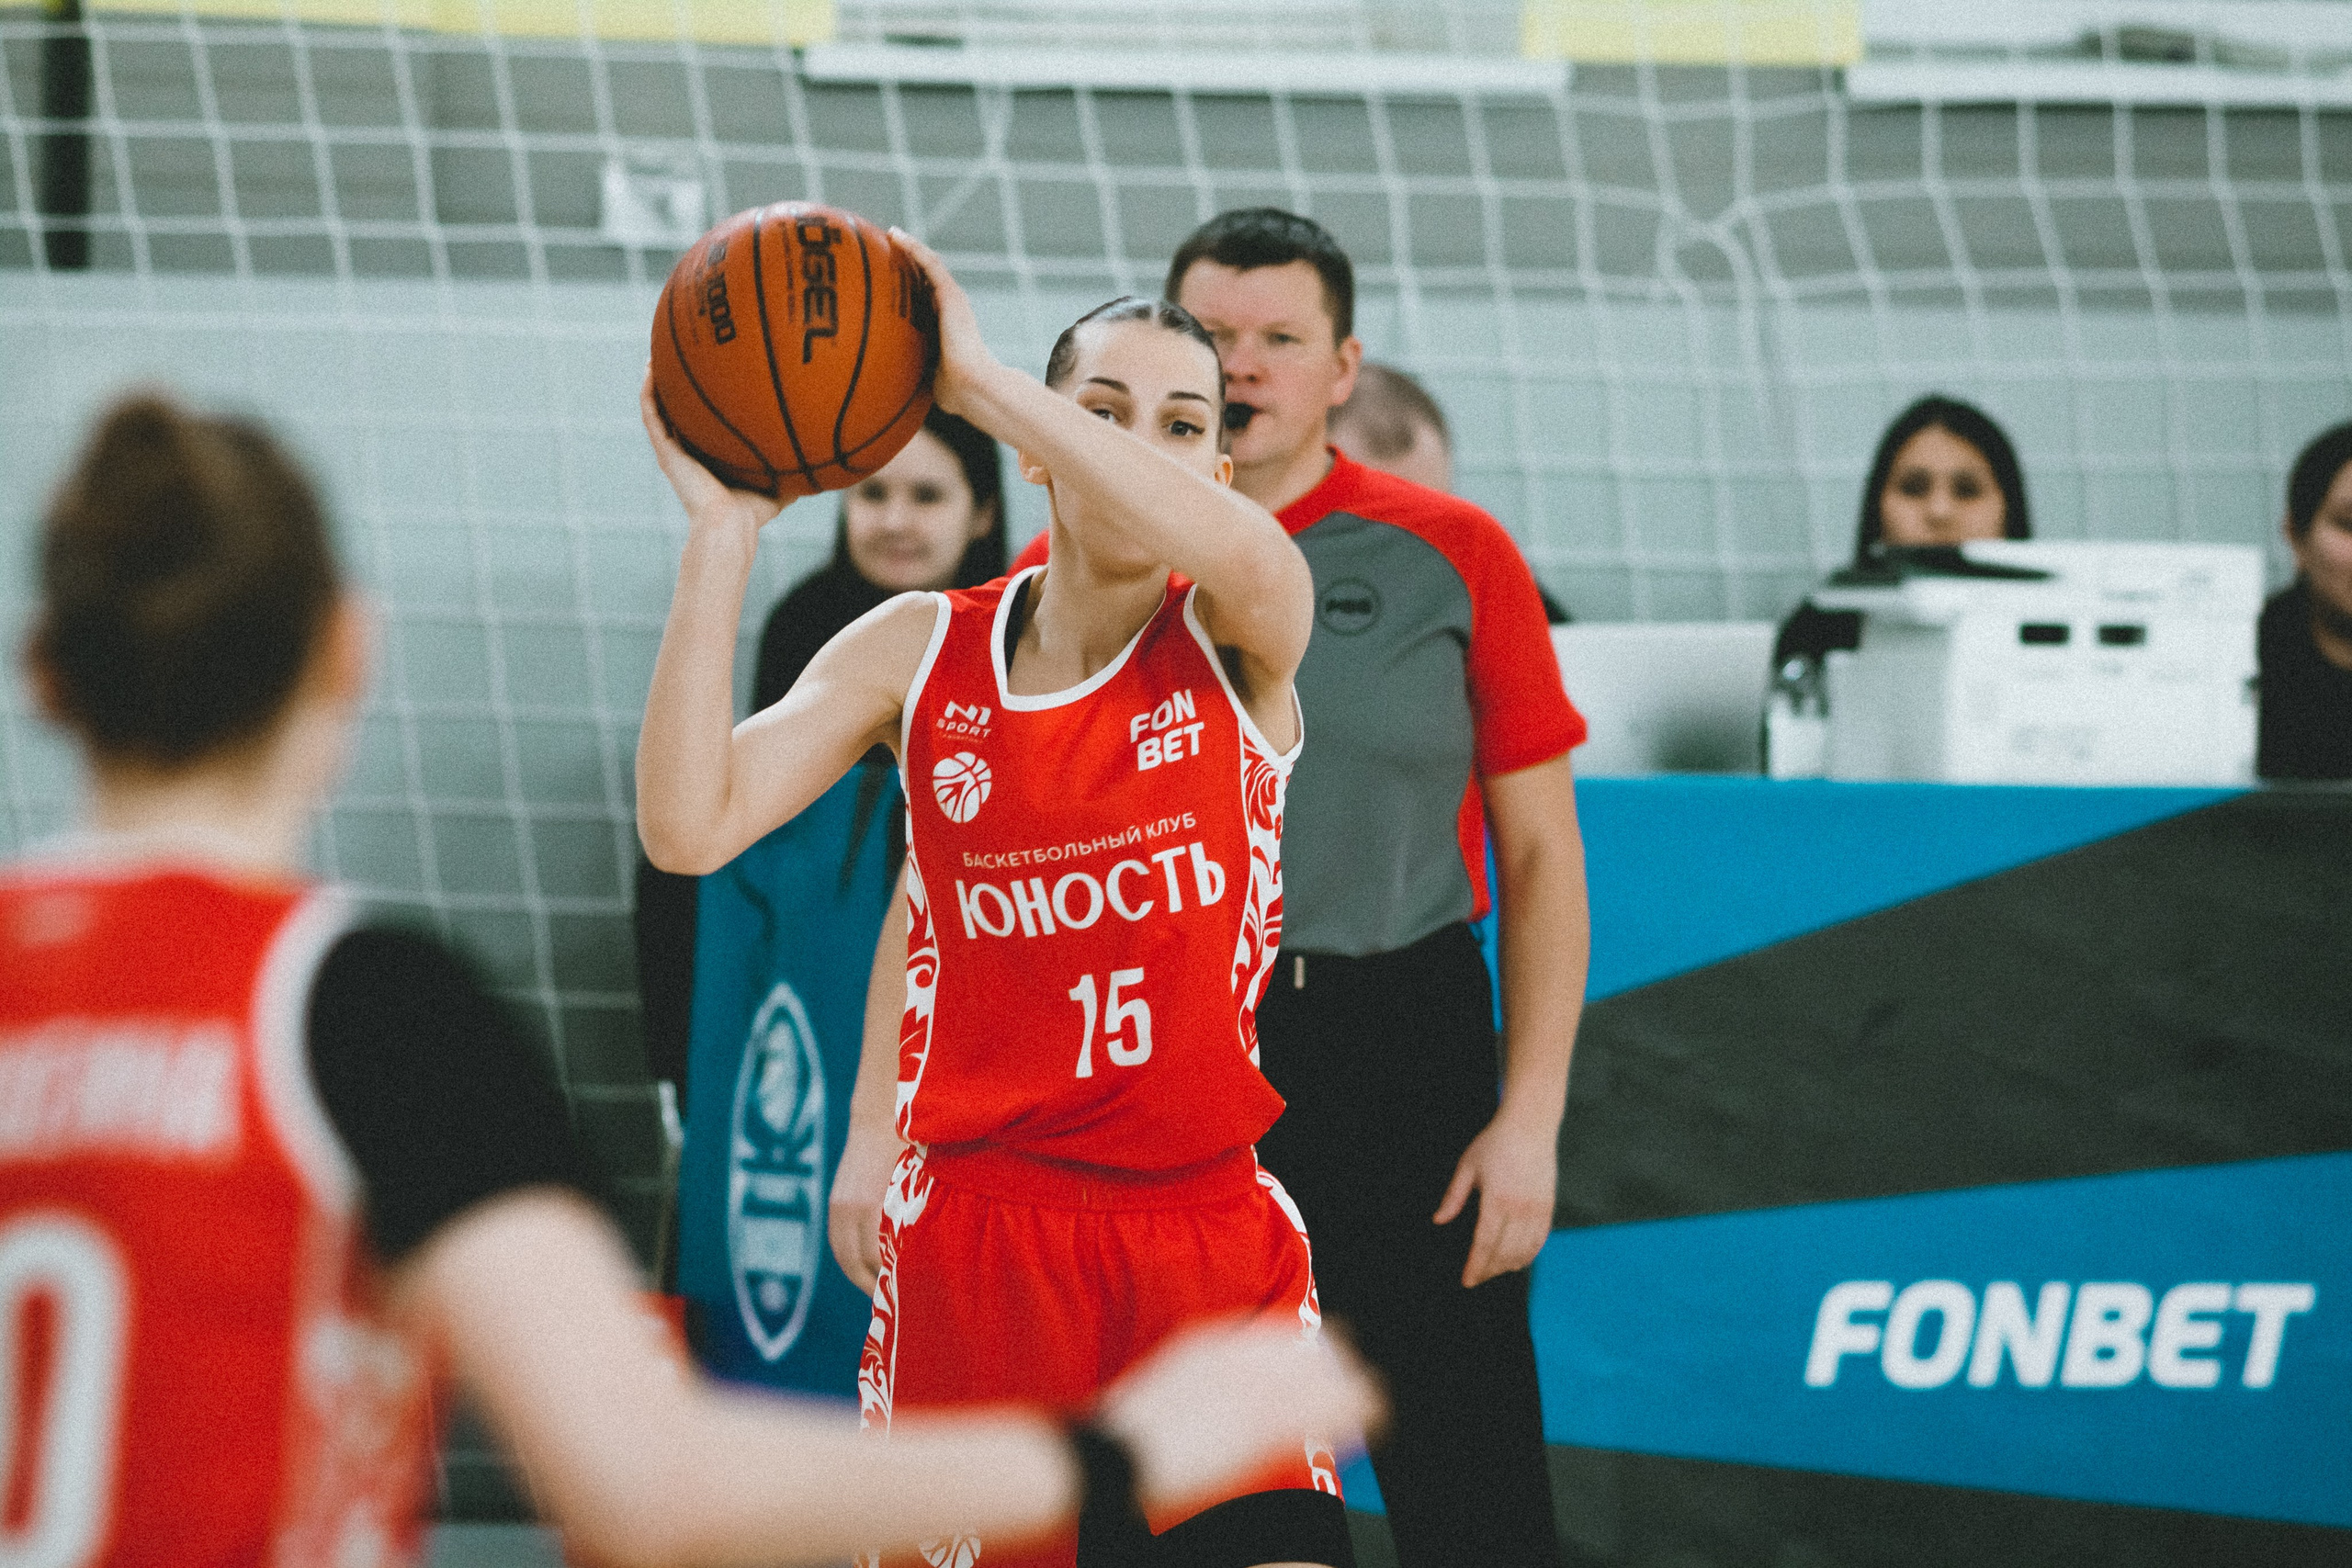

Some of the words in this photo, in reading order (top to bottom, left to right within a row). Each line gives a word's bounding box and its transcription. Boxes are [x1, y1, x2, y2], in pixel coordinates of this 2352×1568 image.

[936, 717, 992, 739] SPORT
[1129, 688, 1196, 744] FON
[1136, 721, 1204, 772] BET
[963, 825, 1142, 869] БАСКЕТБОЛЬНЫЙ
[1145, 812, 1196, 838] КЛУБ
[956, 841, 1226, 939] ЮНОСТЬ
[1069, 966, 1152, 1078] 15
[1804, 1279, 2317, 1390] FONBET
